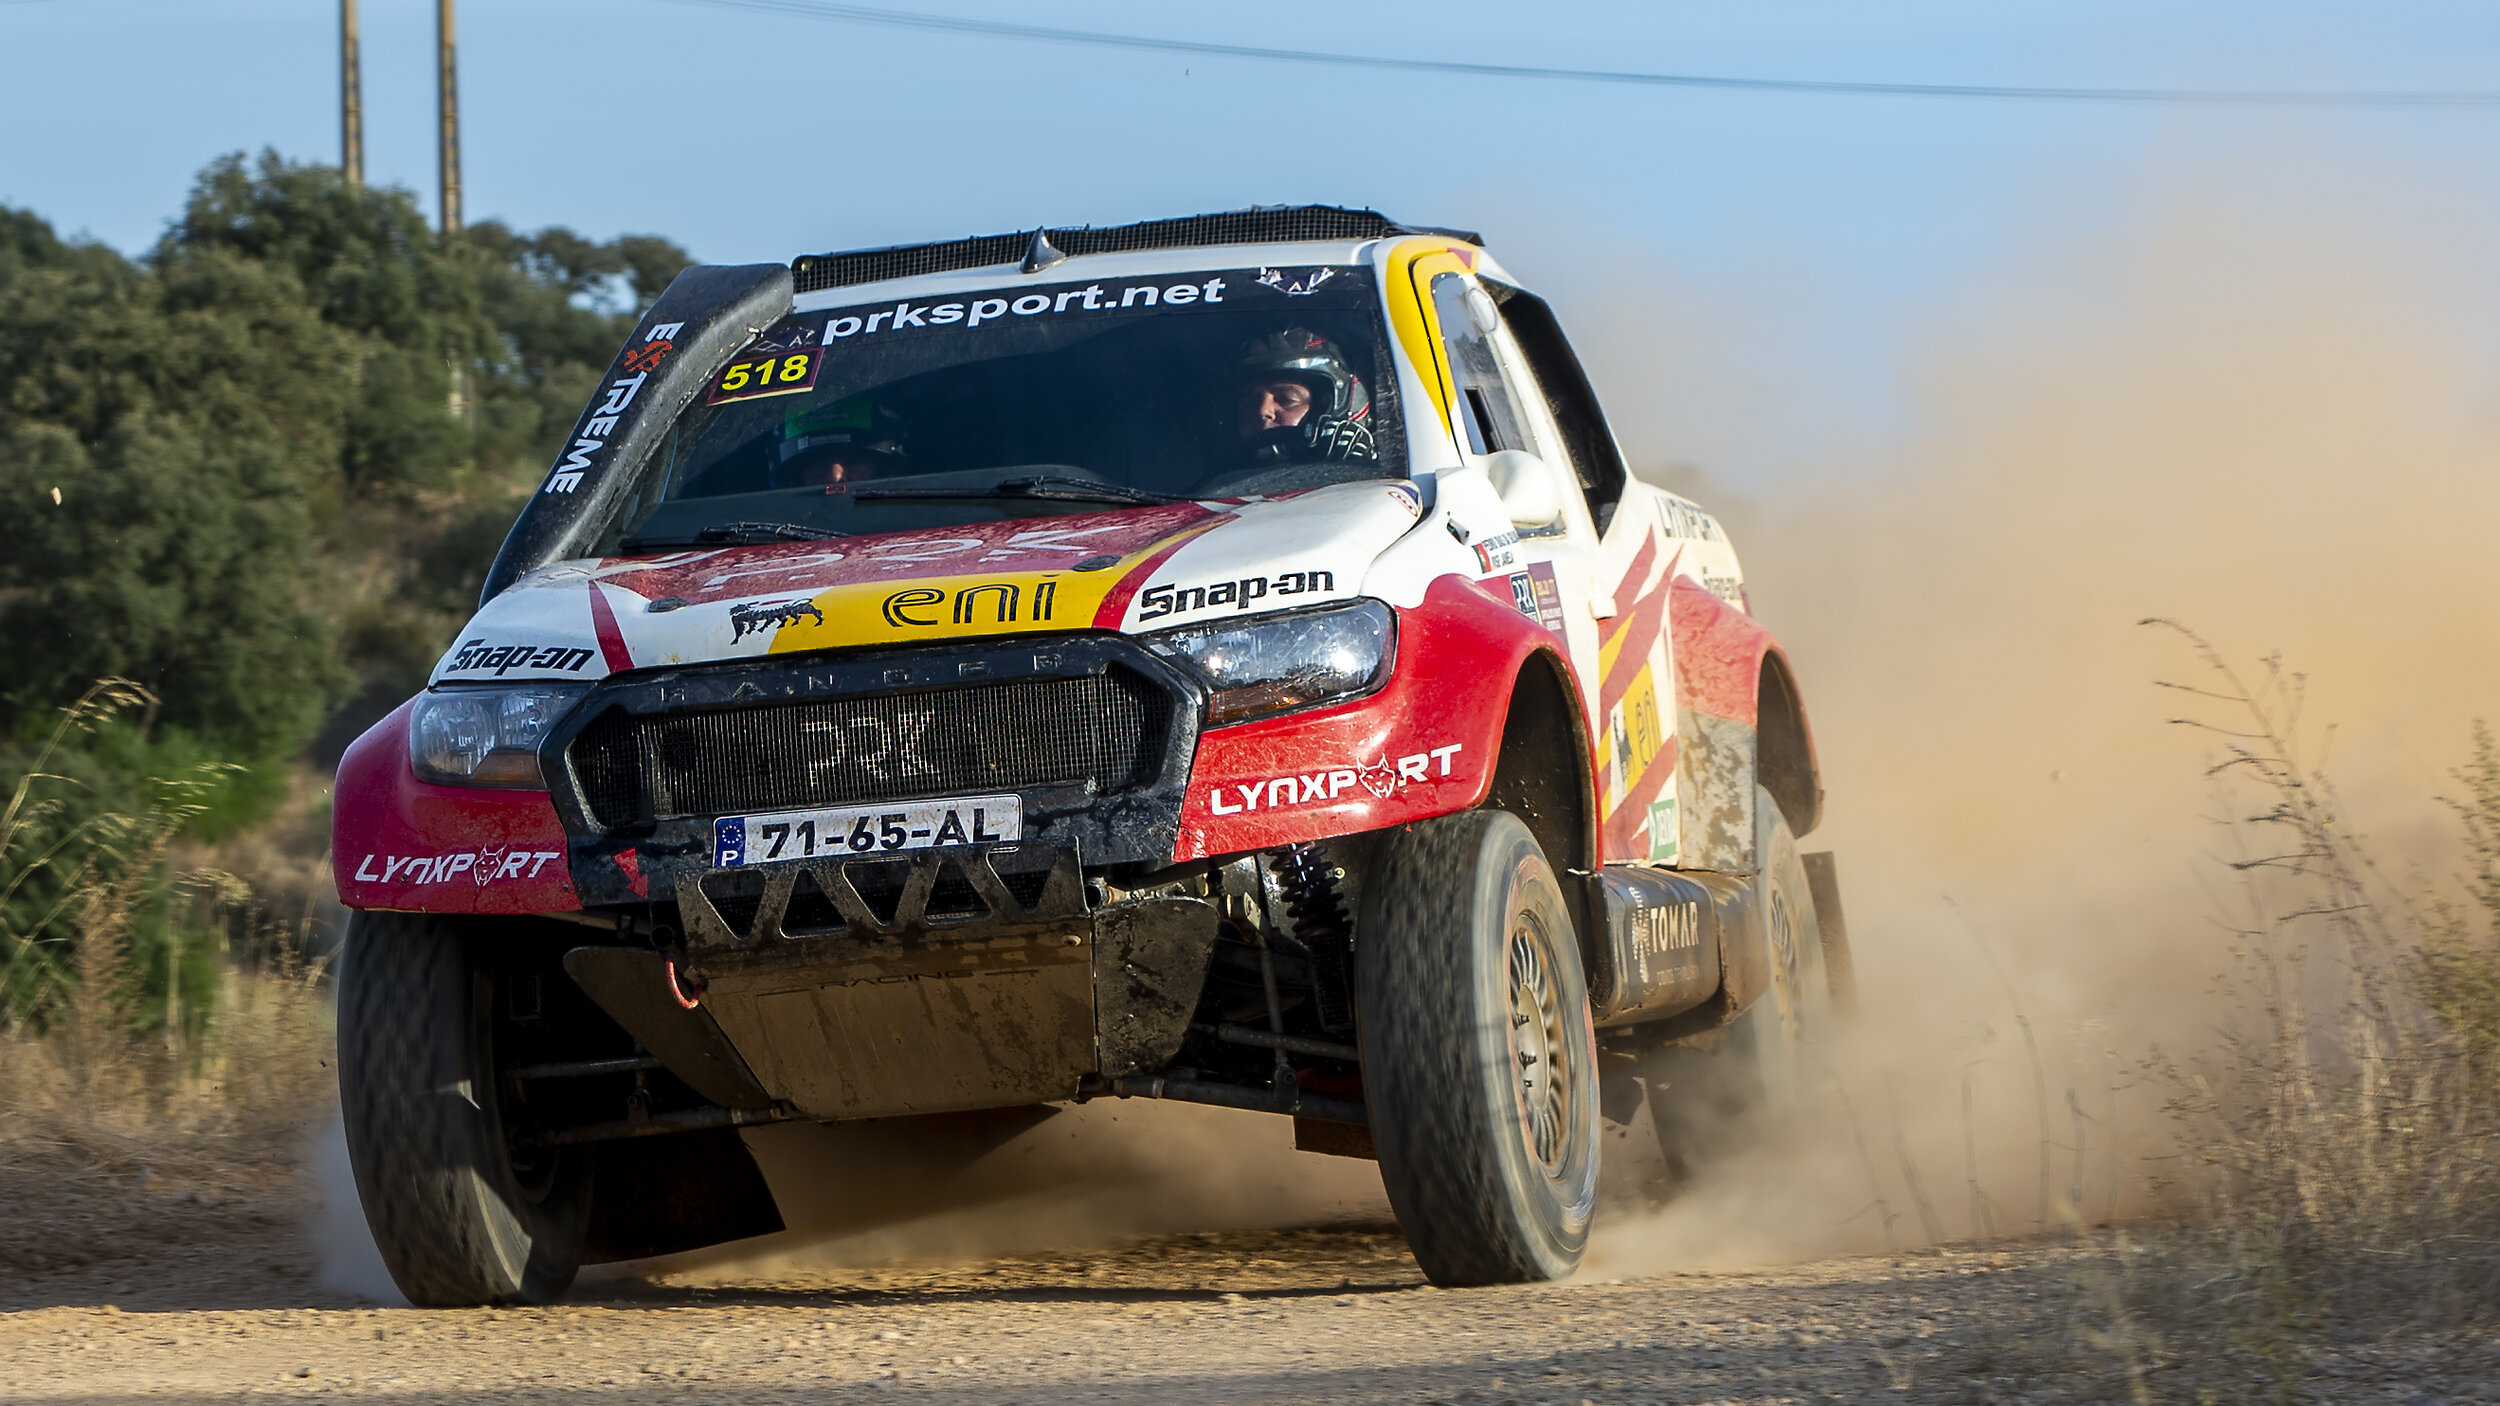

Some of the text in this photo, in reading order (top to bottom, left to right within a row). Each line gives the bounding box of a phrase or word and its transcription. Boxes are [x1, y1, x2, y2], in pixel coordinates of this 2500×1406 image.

[822, 277, 1227, 345] prksport.net
[721, 354, 809, 391] 518
[882, 574, 1058, 628] eni
[1139, 570, 1334, 622] Snap-on
[446, 639, 595, 676] Snap-on
[722, 850, 738, 867] P
[761, 808, 1001, 860] 71-65-AL
[1650, 901, 1699, 953] TOMAR
